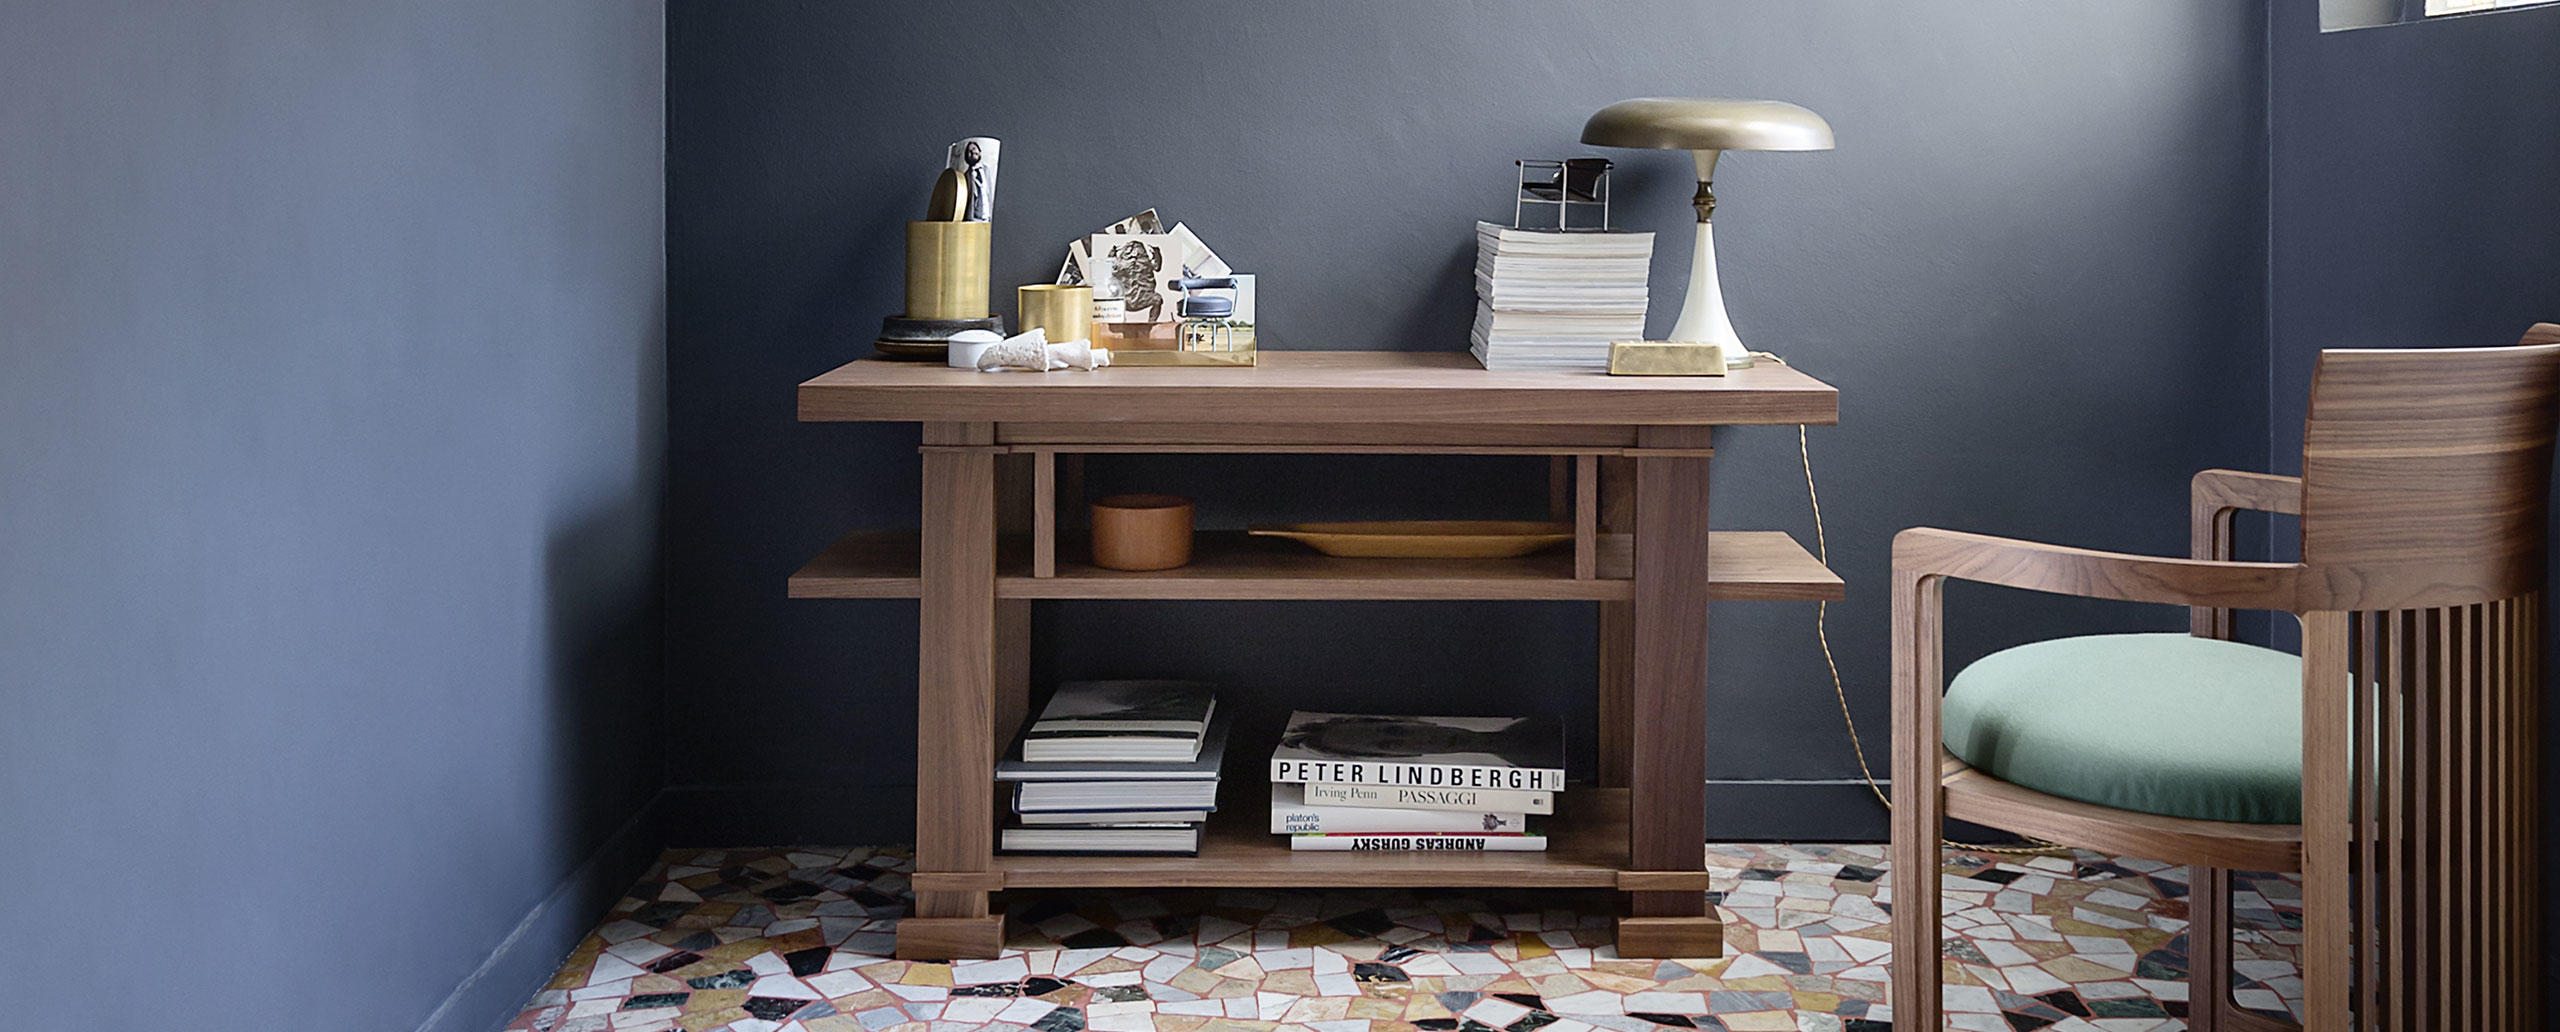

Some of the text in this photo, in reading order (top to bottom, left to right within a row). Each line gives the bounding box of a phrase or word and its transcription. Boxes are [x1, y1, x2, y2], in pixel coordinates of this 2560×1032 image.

[1279, 762, 1363, 783] PETER
[1379, 765, 1542, 789] LINDBERGH
[1315, 785, 1377, 802] Irving Penn
[1399, 789, 1476, 805] PASSAGGI
[1286, 813, 1320, 824] platon's
[1286, 823, 1320, 833] republic
[1351, 838, 1486, 851] ANDREAS GURSKY
